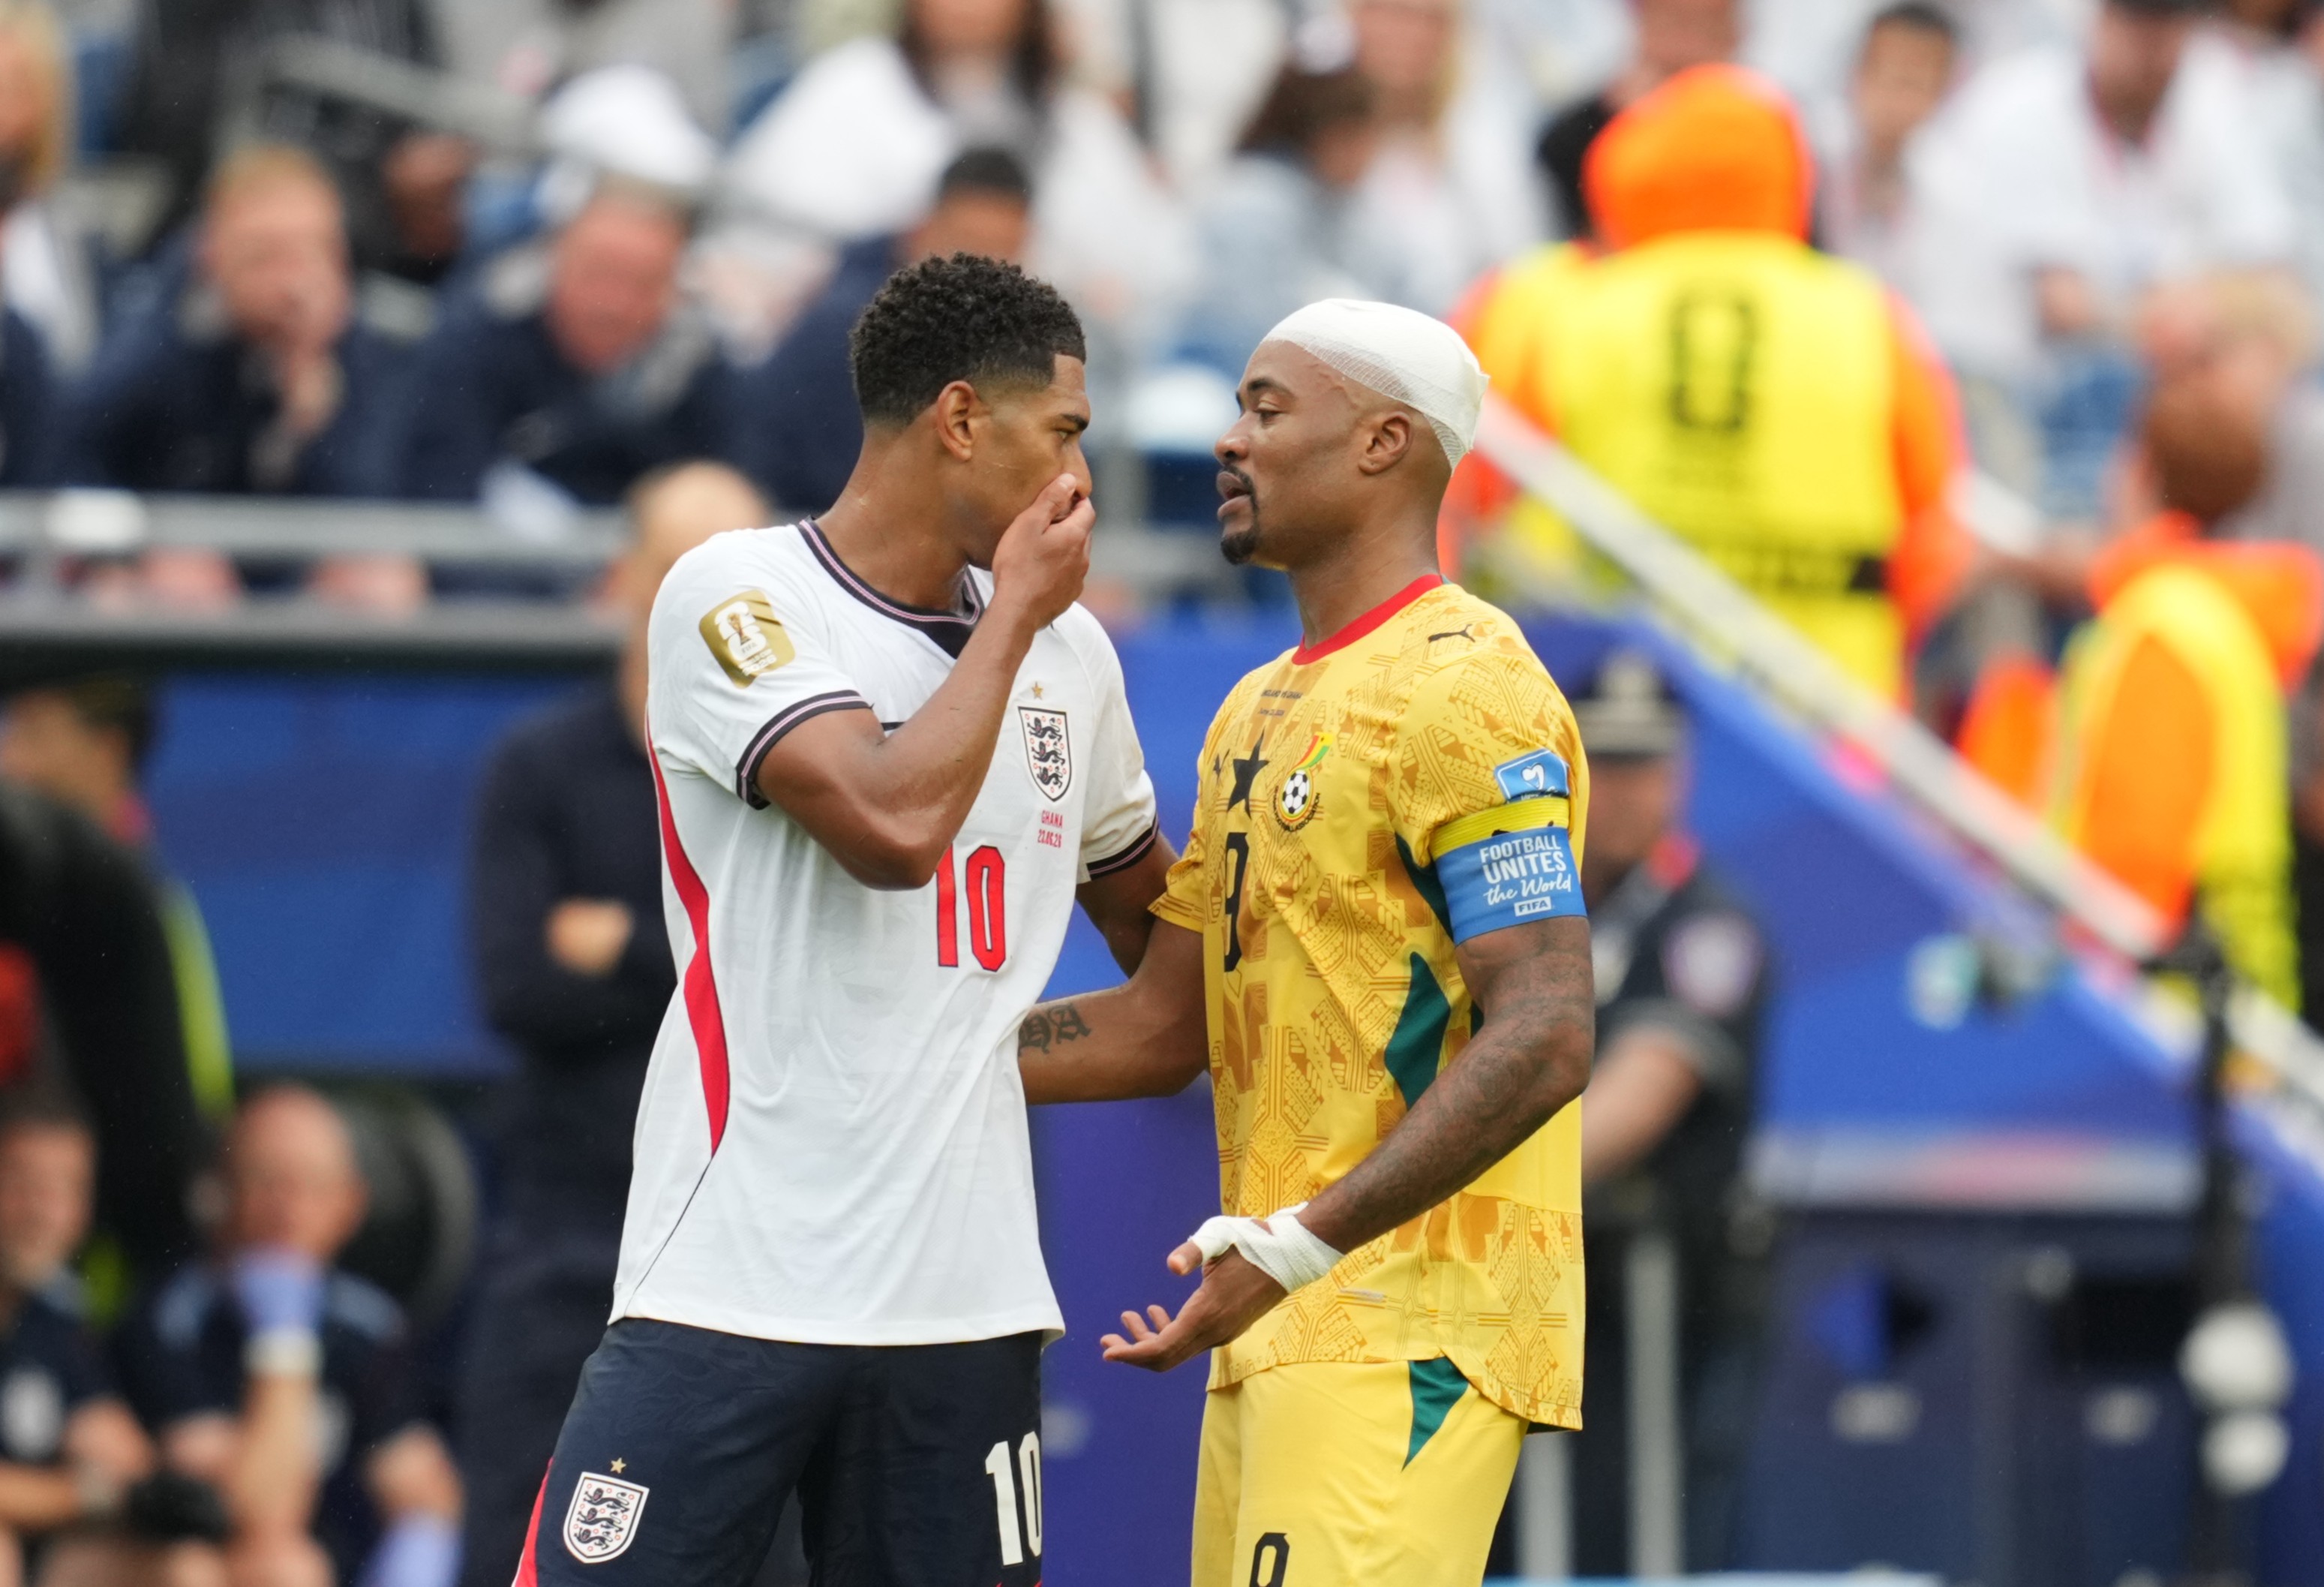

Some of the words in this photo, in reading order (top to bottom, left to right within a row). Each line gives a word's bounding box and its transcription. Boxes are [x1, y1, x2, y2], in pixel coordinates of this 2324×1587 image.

[1041, 809, 1064, 829] GHANA
[1479, 834, 1562, 864] FOOTBALL
[1482, 850, 1567, 885] UNITES
[1224, 831, 1250, 972] 9
[1482, 883, 1518, 906] the
[1519, 872, 1572, 898] World
[1517, 898, 1550, 914] FIFA
[935, 842, 1007, 972] 10
[984, 1430, 1043, 1567] 10
